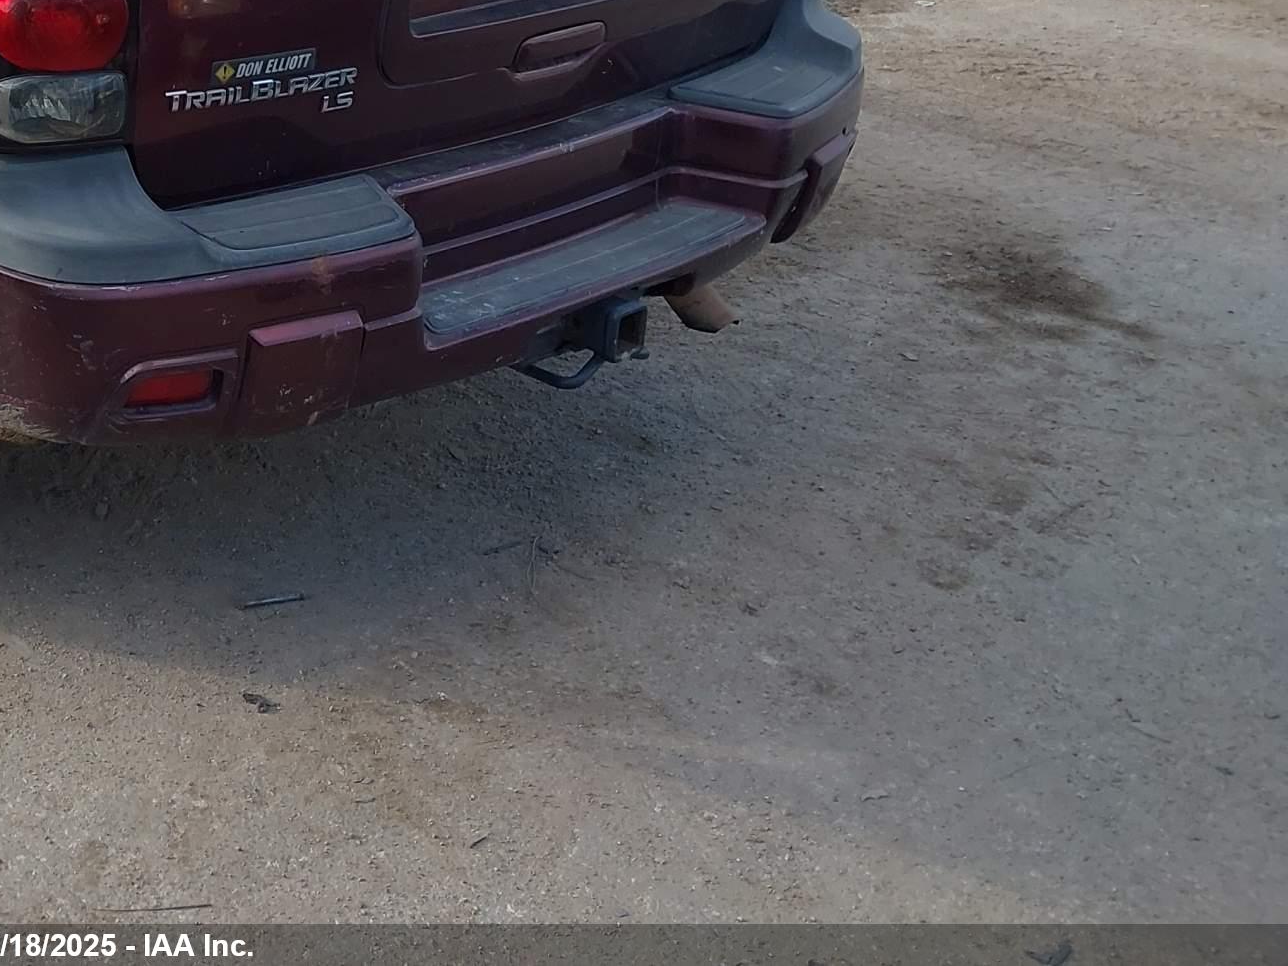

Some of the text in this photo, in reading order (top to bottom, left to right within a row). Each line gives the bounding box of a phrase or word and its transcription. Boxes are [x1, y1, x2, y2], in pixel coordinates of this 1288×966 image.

[235, 53, 312, 78] DON ELLIOTT
[165, 67, 357, 112] TRAILBLAZER
[320, 91, 354, 113] LS
